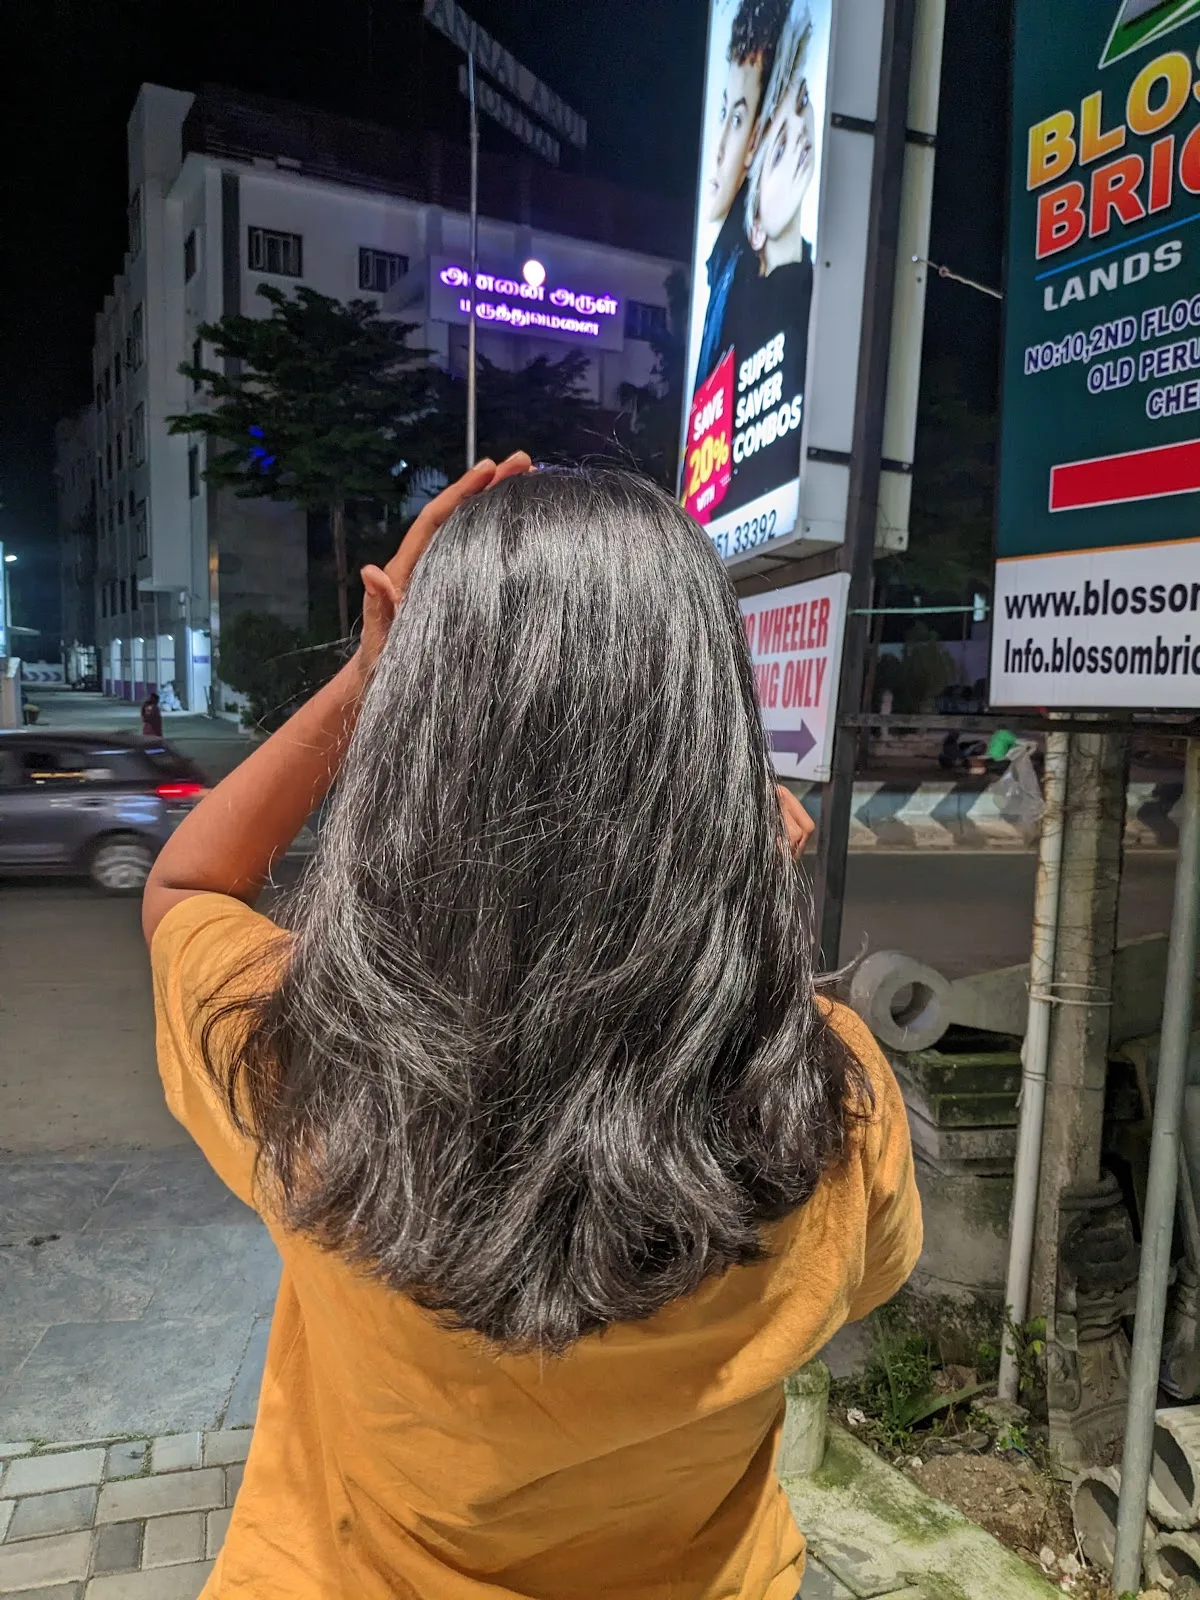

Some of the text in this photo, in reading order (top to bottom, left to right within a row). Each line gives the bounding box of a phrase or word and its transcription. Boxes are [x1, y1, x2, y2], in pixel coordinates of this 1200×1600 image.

[1027, 44, 1200, 191] BLO
[550, 288, 618, 315] அருள்
[1043, 240, 1182, 311] LANDS
[738, 331, 786, 392] SUPER
[1024, 316, 1136, 375] NO:10,2ND
[735, 371, 784, 428] SAVER
[1087, 357, 1135, 394] OLD
[693, 387, 724, 441] SAVE
[733, 394, 803, 464] COMBOS
[688, 431, 729, 497] 20%
[712, 509, 776, 559] 51 33392
[757, 597, 830, 656] WHEELER
[1005, 579, 1200, 619] www.blosso
[781, 656, 828, 709] ONLY
